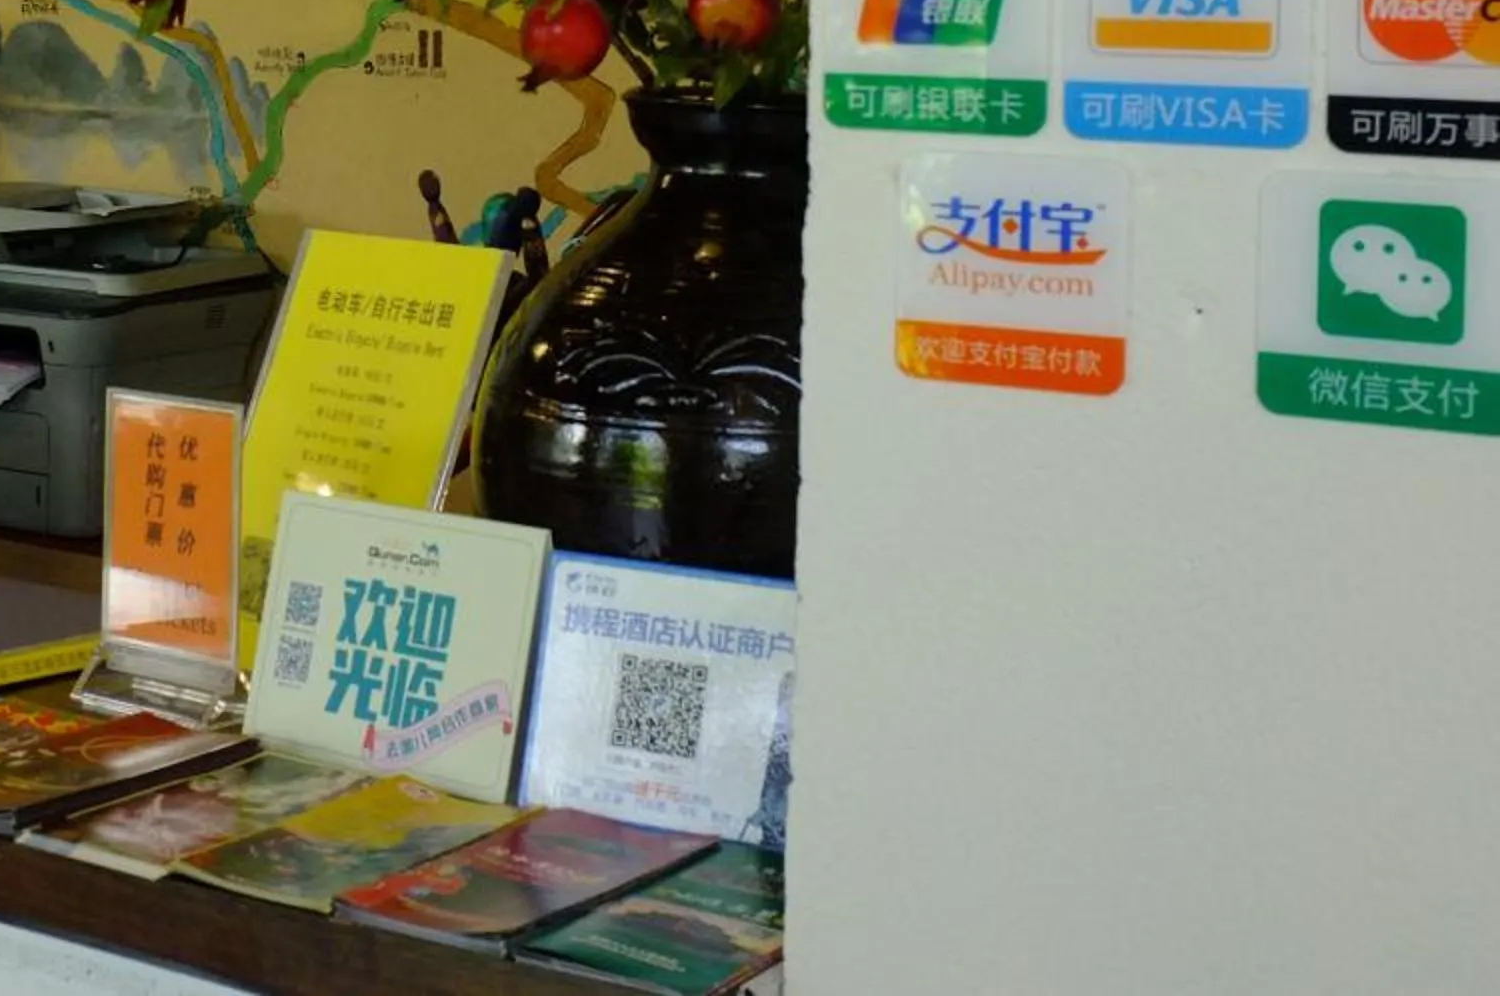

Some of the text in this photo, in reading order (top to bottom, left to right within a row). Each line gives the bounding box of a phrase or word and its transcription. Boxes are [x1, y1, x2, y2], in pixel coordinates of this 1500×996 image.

[845, 81, 1025, 125] 可刷银联卡
[1080, 92, 1286, 136] 可刷VISA卡
[1350, 108, 1500, 149] 可刷万事
[916, 196, 1097, 262] 支付宝
[928, 261, 1095, 298] Alipay.com
[916, 335, 1102, 377] 欢迎支付宝付款
[1307, 366, 1480, 419] 微信支付
[145, 433, 166, 548] 代购门票
[176, 435, 198, 555] 优惠价
[336, 579, 456, 662] 欢迎
[563, 603, 795, 659] 携程酒店认证商户
[324, 649, 443, 729] 光临
